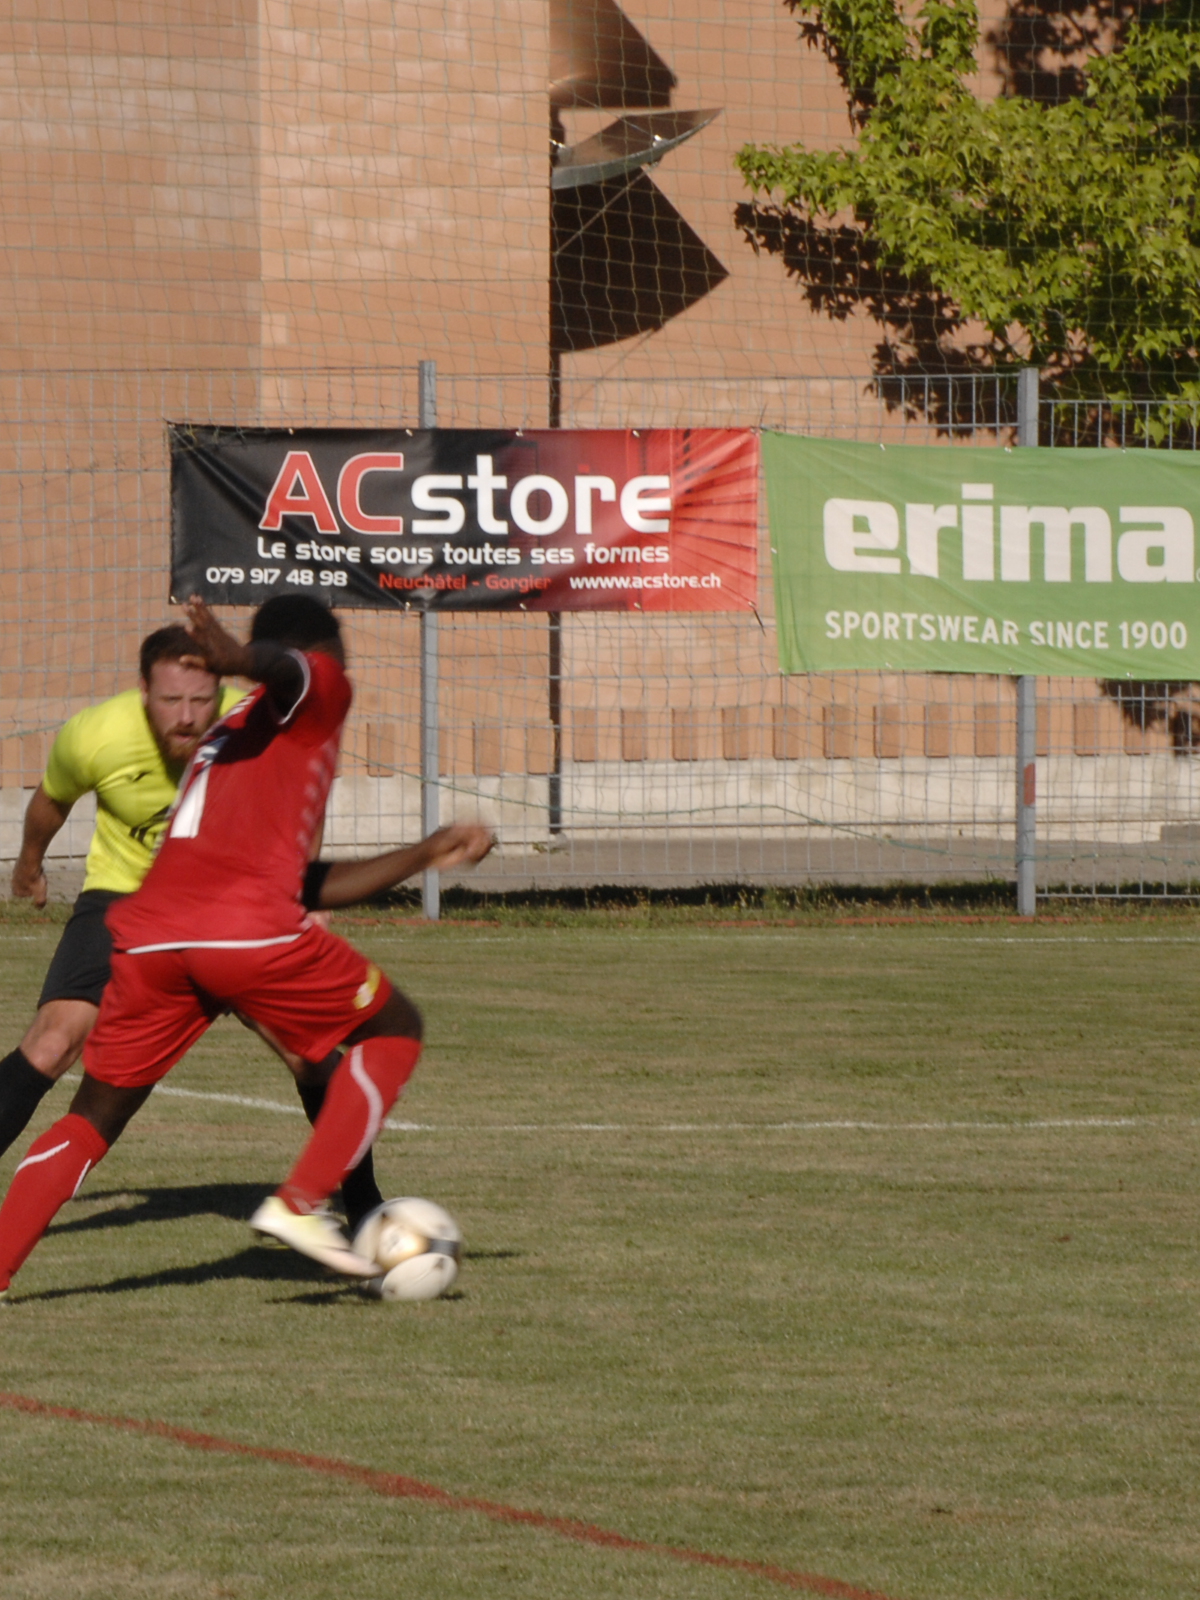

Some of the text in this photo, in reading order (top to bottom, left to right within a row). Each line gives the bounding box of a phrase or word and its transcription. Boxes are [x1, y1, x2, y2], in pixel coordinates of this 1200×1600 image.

[823, 483, 1195, 583] erima
[257, 536, 670, 565] Le store sous toutes ses formes
[206, 567, 245, 584] 079
[249, 568, 281, 585] 917
[286, 569, 314, 585] 48
[319, 570, 348, 587] 98
[378, 573, 467, 590] Neuchâtel
[485, 574, 552, 594] Gorgier
[825, 610, 1188, 649] SPORTSWEAR SINCE 1900
